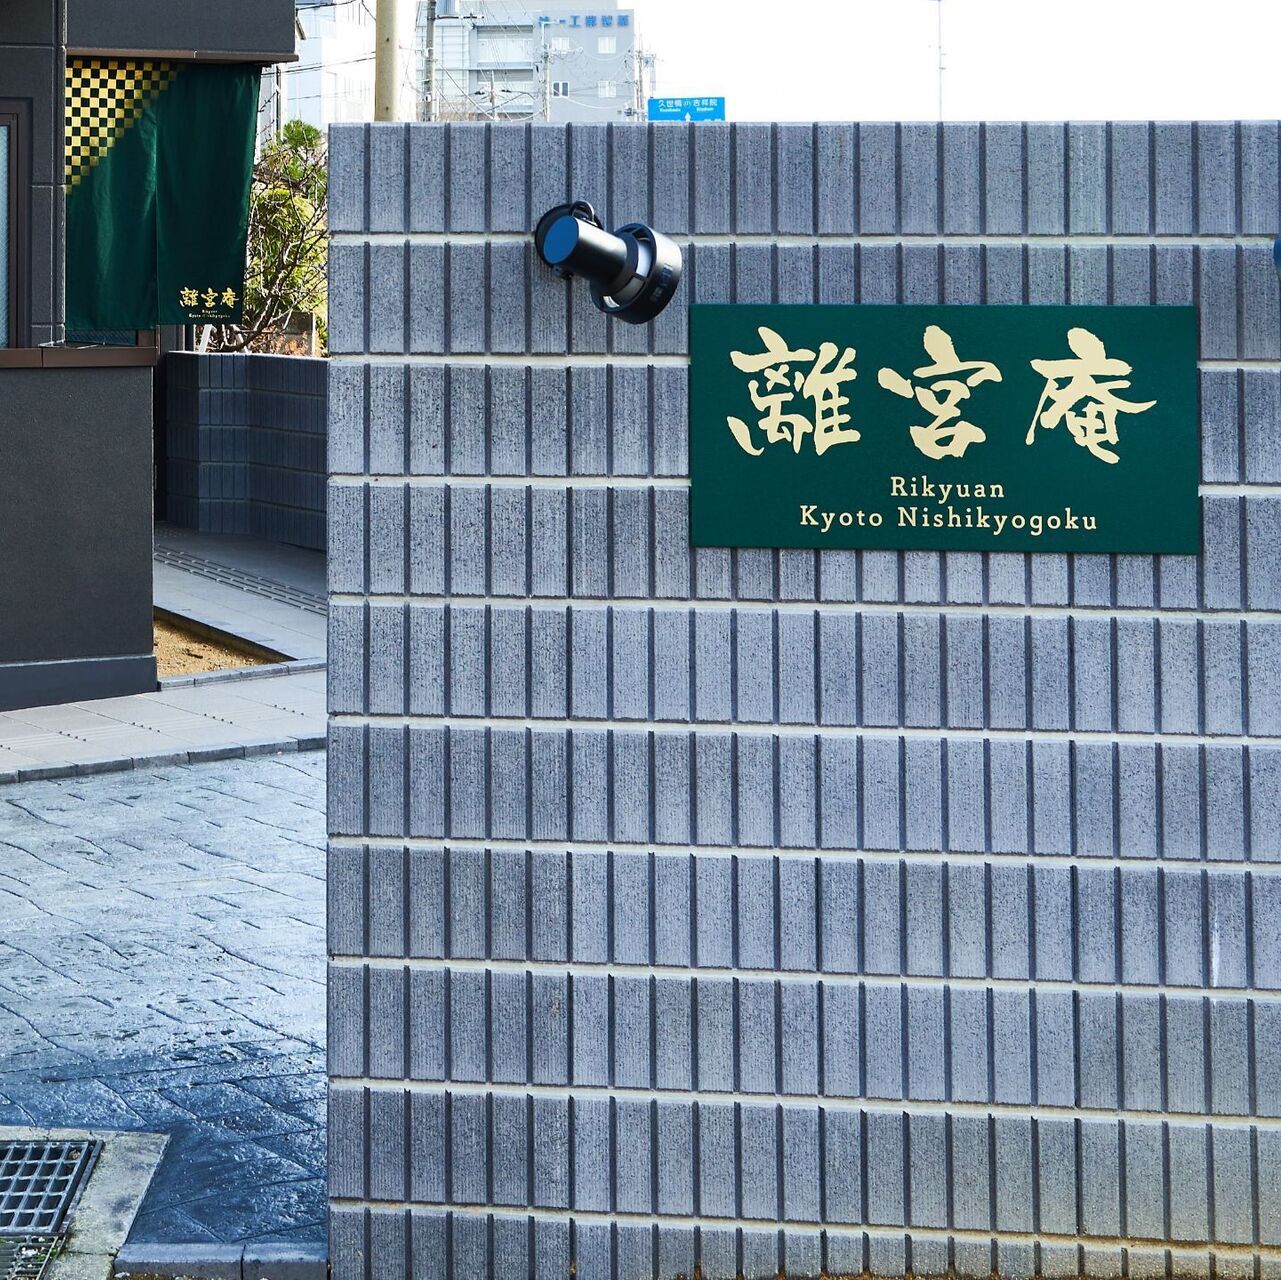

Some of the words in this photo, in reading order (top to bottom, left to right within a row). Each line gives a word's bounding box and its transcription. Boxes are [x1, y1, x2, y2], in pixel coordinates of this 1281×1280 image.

[726, 324, 1158, 464] 離宮庵
[890, 475, 1006, 505] Rikyuan
[799, 505, 884, 533] Kyoto
[897, 506, 1098, 536] Nishikyogoku
